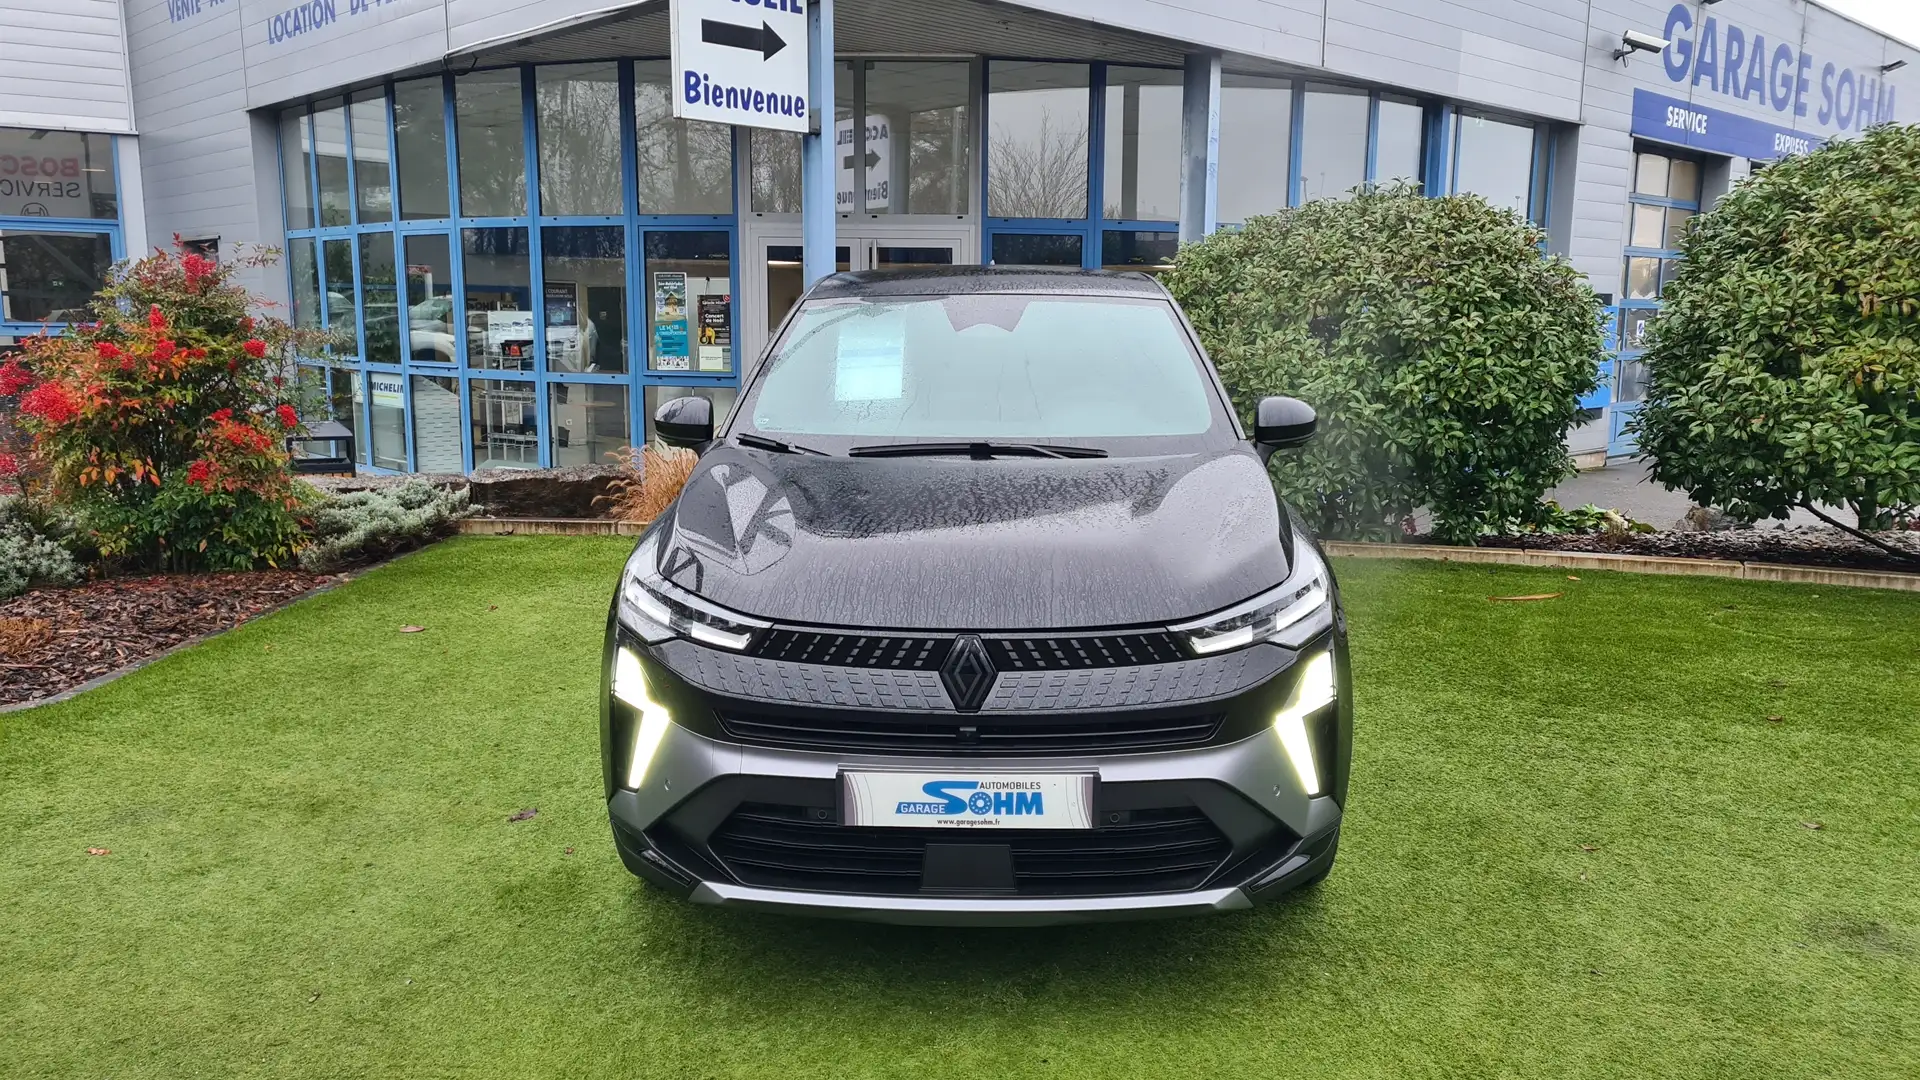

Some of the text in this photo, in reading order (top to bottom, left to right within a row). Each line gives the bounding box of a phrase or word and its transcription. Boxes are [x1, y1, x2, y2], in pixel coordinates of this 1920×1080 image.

[268, 0, 336, 45] LOCATION
[1662, 3, 1896, 132] GARAGE SOHM
[684, 70, 805, 118] Bienvenue
[1666, 105, 1809, 157] SERVICE EXPRESS
[922, 780, 1044, 816] SOHM
[979, 781, 1041, 790] AUTOMOBILES
[900, 803, 946, 814] GARAGE
[937, 818, 1001, 827] www.garagesohm.fr
